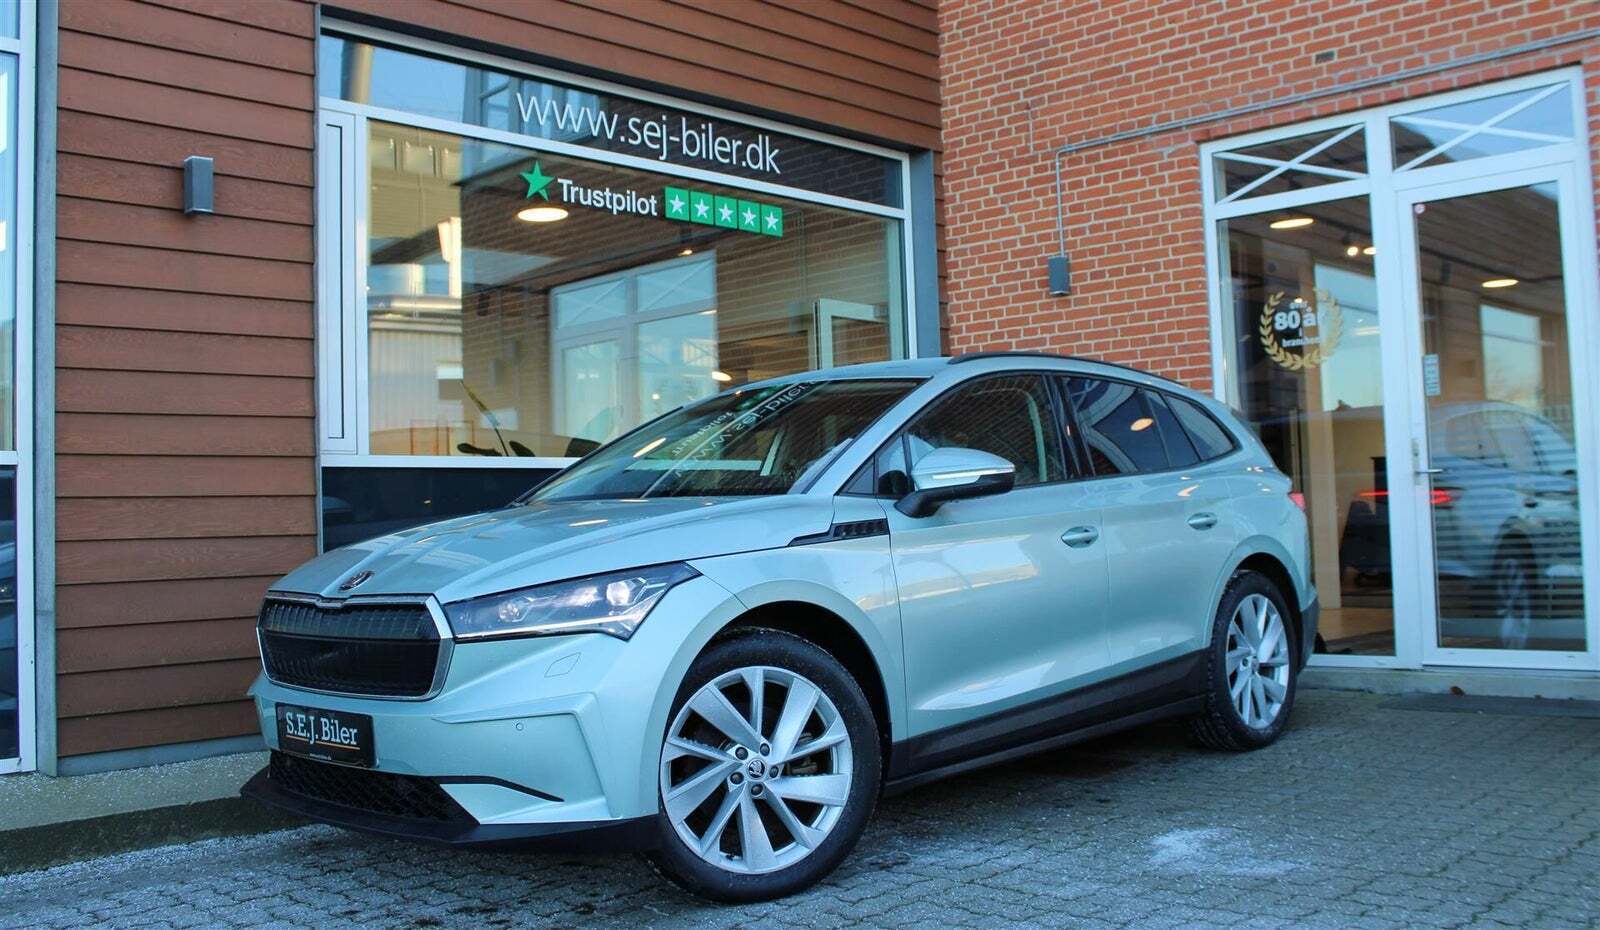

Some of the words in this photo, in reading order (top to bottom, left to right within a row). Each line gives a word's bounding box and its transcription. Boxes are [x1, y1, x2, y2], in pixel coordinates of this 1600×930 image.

[516, 92, 781, 174] www.sej-biler.dk
[557, 177, 658, 216] Trustpilot
[1274, 310, 1301, 330] 80
[285, 711, 319, 745] S.E.J.
[320, 717, 358, 745] Biler
